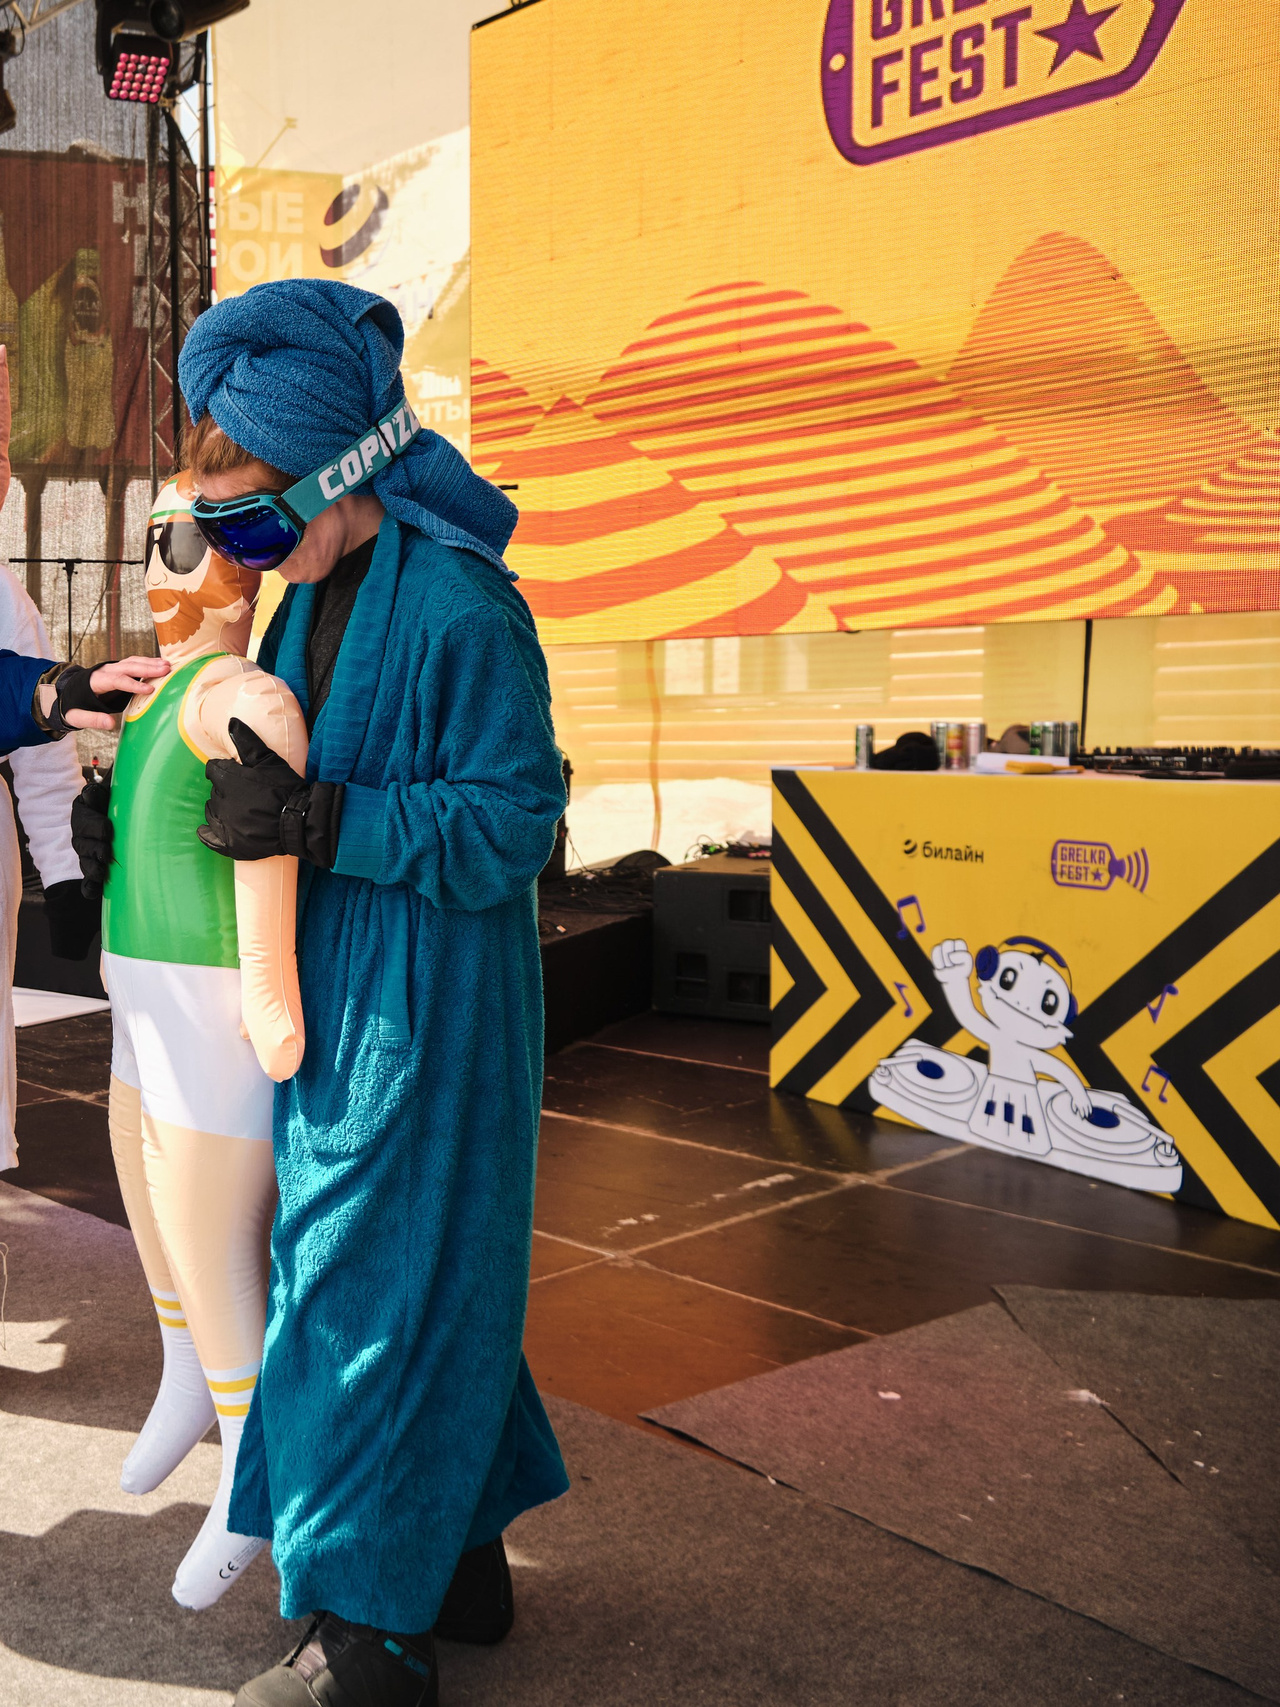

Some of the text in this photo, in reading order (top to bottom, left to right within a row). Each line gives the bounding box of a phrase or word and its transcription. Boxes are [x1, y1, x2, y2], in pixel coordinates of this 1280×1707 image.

[871, 6, 1033, 129] FEST
[922, 841, 984, 864] билайн
[1059, 846, 1106, 866] GRELKA
[1059, 863, 1091, 882] FEST
